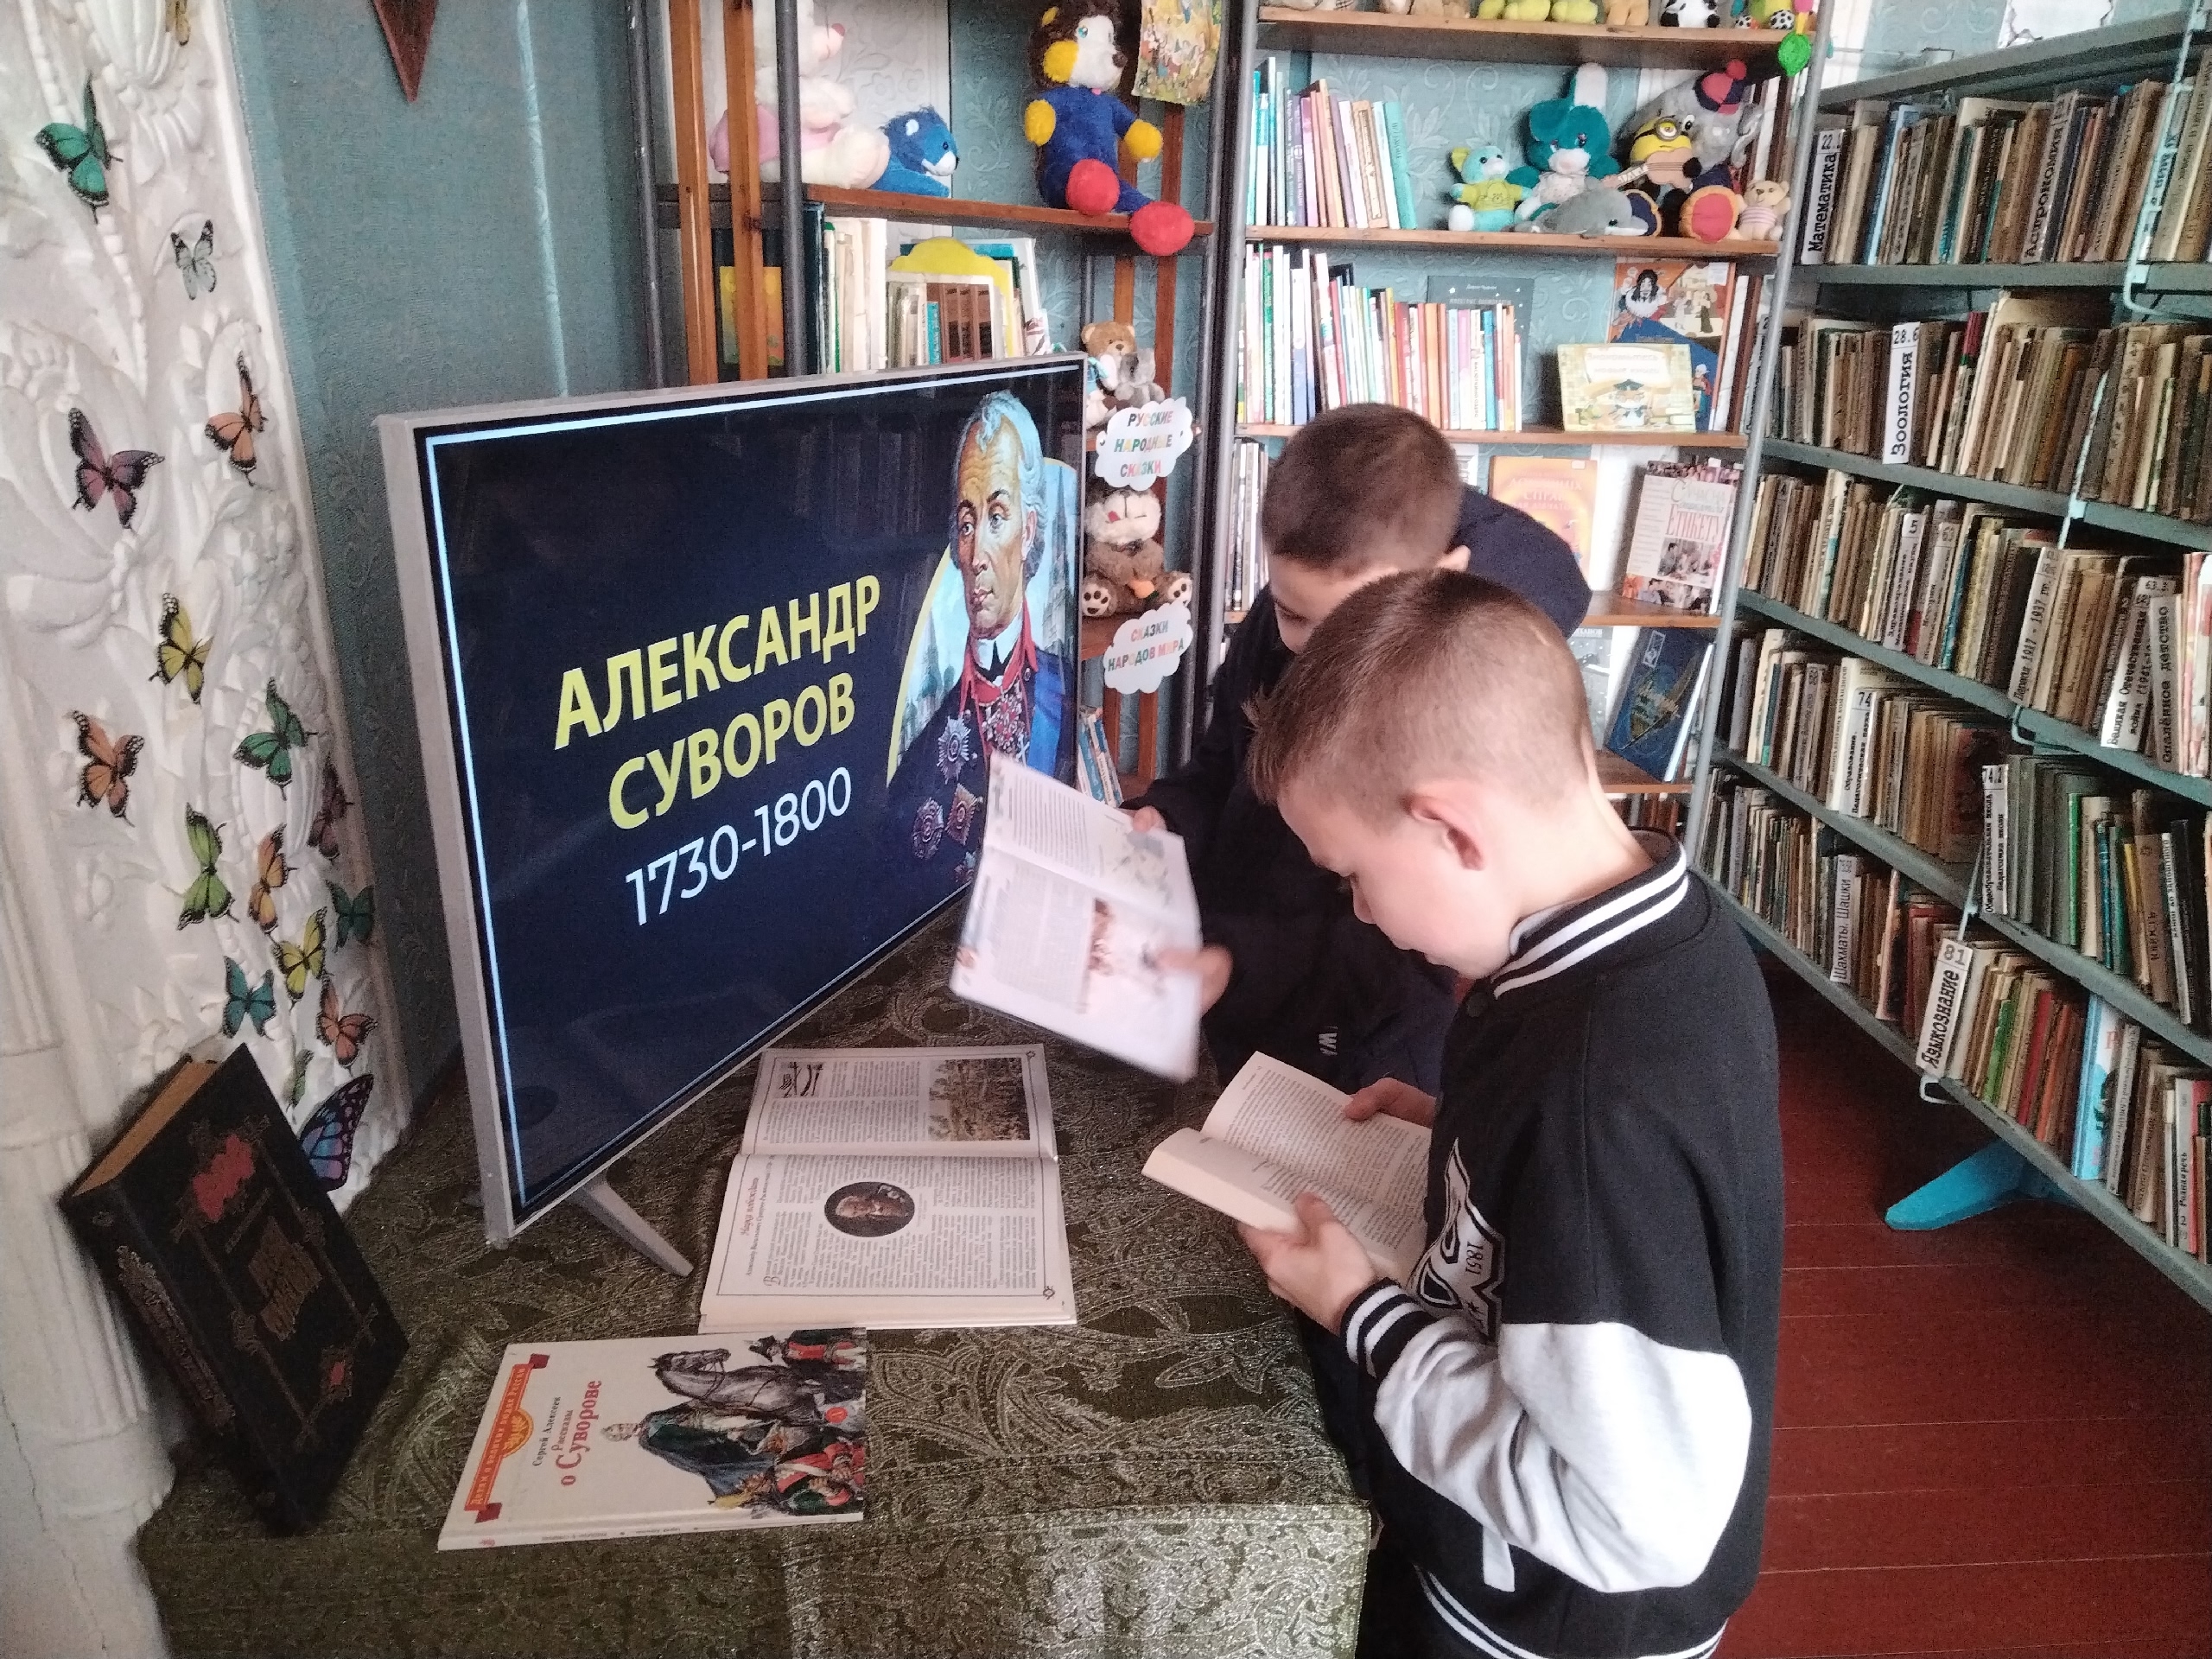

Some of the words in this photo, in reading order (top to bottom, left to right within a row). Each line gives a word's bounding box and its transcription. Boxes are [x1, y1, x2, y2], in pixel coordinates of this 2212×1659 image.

[1808, 152, 1837, 253] Математика
[2024, 127, 2063, 258] Астрономия
[1128, 410, 1173, 428] РУССКИЕ
[1890, 351, 1913, 456] Зоология
[1114, 434, 1173, 453] НАРОДНЫЕ
[1120, 461, 1161, 478] СКАЗКИ
[1108, 646, 1156, 672] НАРОДОВ
[1158, 638, 1185, 657] МИРА
[1130, 620, 1169, 642] СКАЗКИ
[2021, 638, 2037, 662] 1917
[2157, 607, 2171, 671] детство
[553, 574, 881, 750] АЛЕКСАНДР
[1858, 692, 1873, 708] 74
[2159, 680, 2172, 763] Опалённое
[608, 671, 855, 830] СУВОРОВ
[625, 766, 853, 926] 1730-1800
[1836, 878, 1851, 919] Шашки
[1834, 923, 1848, 979] Шахматы.
[1942, 944, 1967, 967] 81
[1921, 969, 1959, 1068] Языкознание
[510, 1367, 526, 1396] России
[532, 1436, 550, 1467] Сергей
[543, 1396, 562, 1434] Алексеев
[551, 1408, 574, 1452] Рассказы
[555, 1379, 602, 1470] Суворове
[560, 1474, 576, 1487] о
